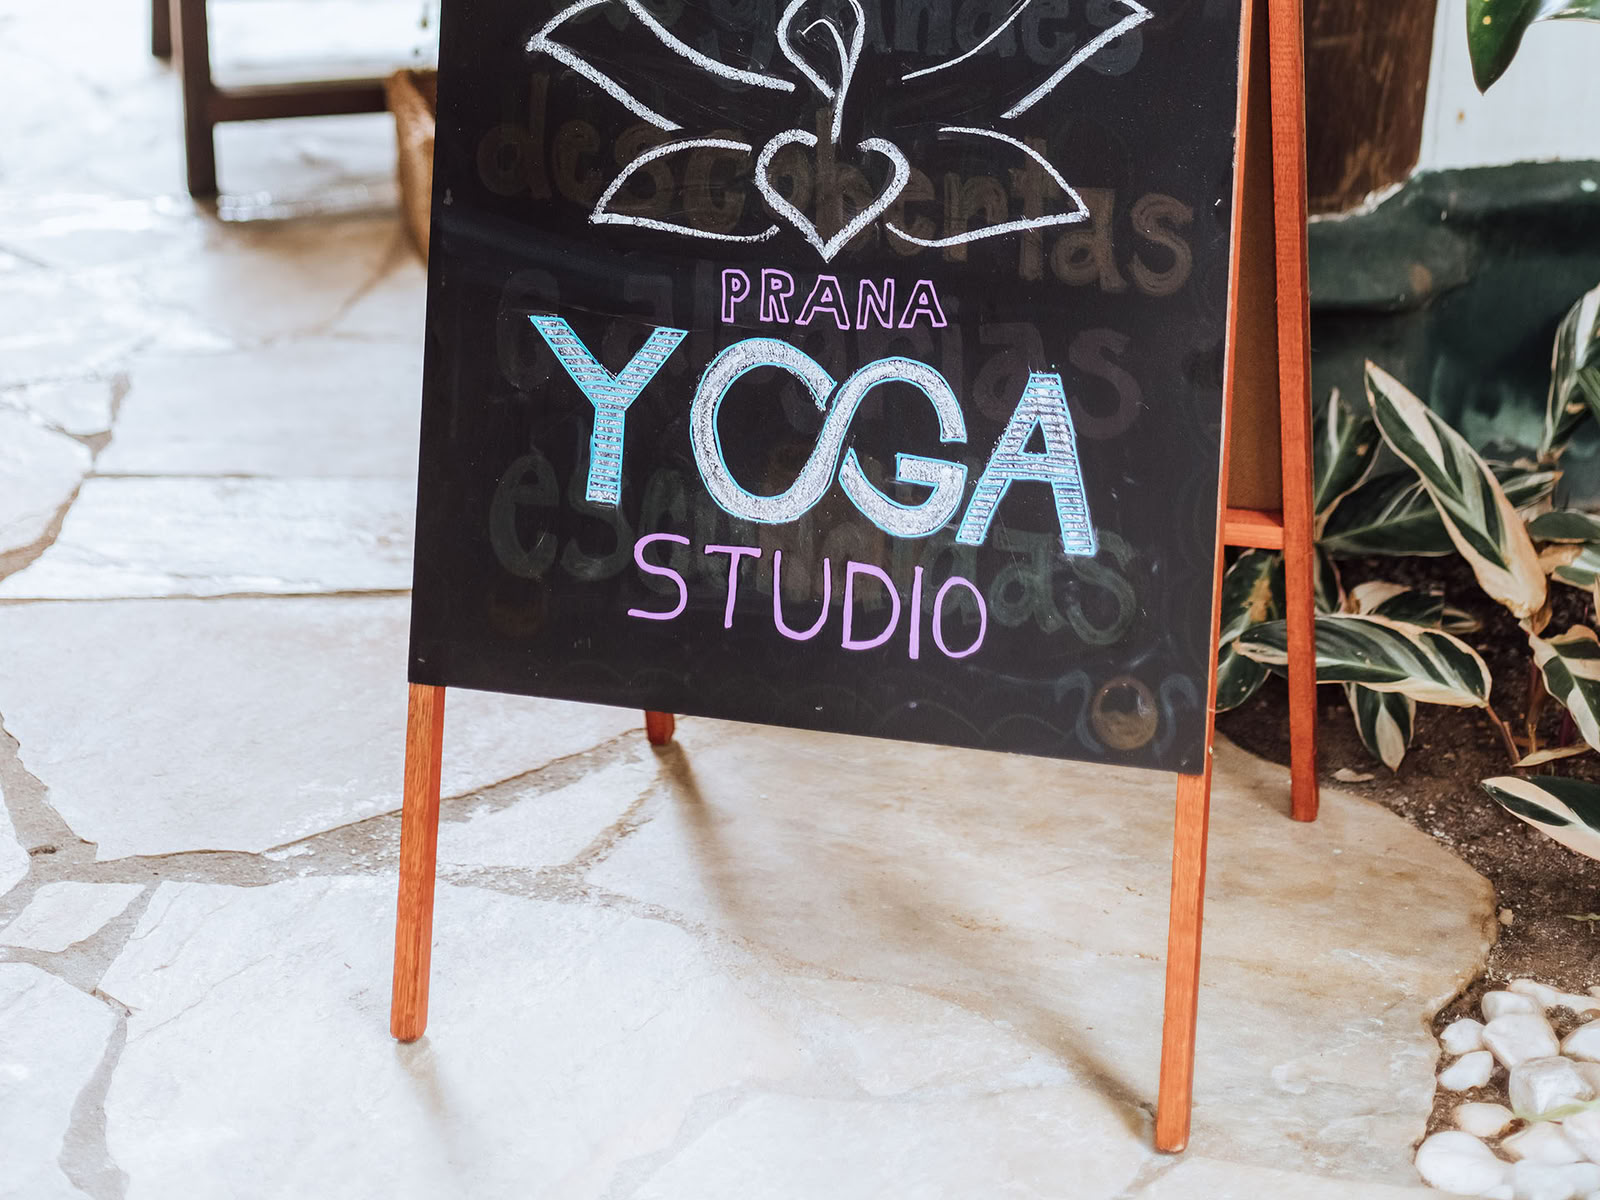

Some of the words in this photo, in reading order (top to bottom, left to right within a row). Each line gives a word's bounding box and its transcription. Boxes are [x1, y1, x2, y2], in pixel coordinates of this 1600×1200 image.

[720, 267, 949, 331] PRANA
[529, 313, 1099, 558] YOGA
[627, 532, 989, 661] STUDIO
